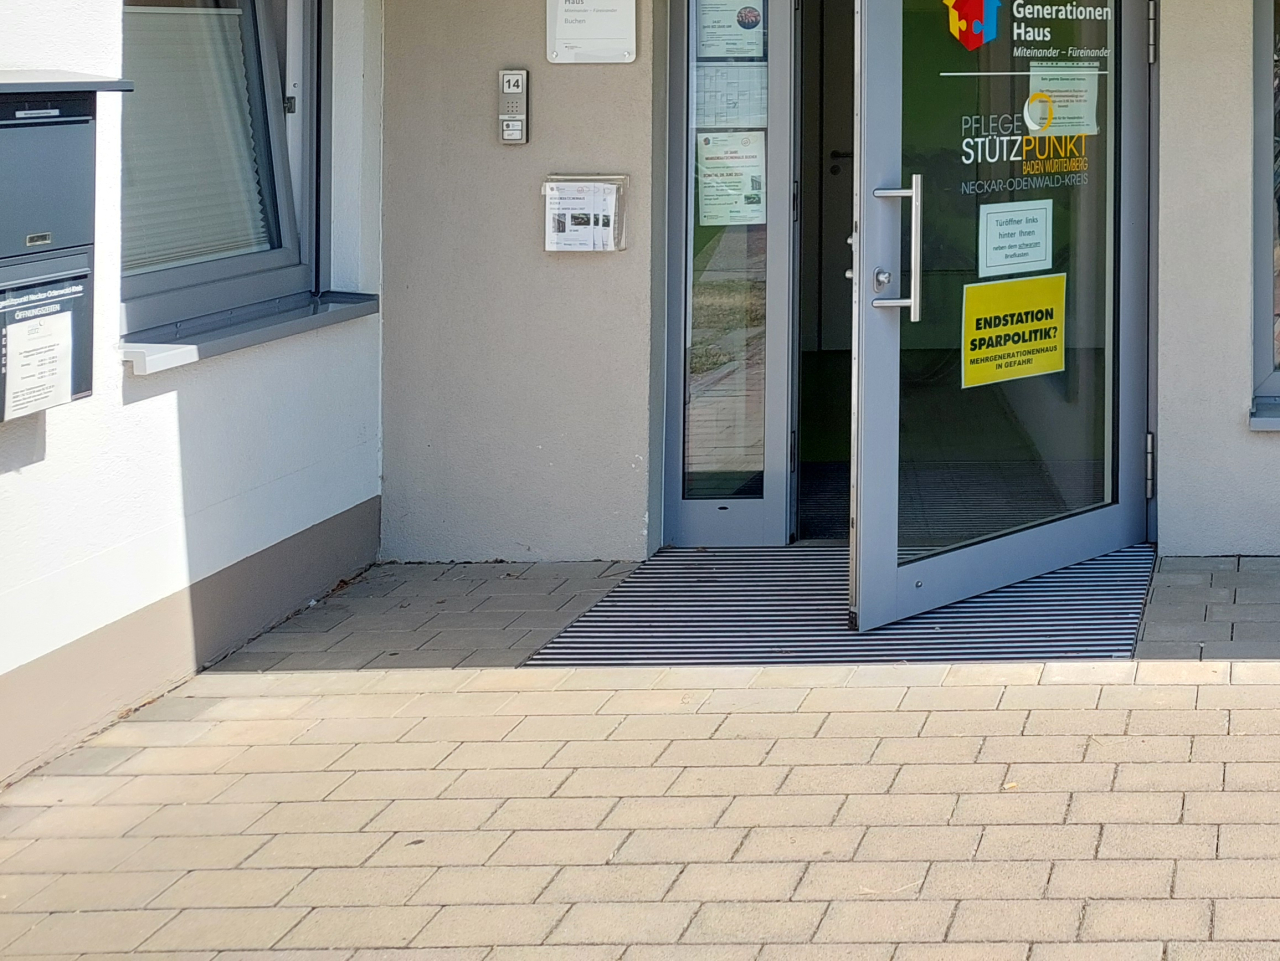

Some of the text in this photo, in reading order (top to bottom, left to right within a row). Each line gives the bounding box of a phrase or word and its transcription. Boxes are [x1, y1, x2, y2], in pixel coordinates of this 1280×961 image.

[1012, 0, 1112, 20] Generationen
[1012, 22, 1051, 41] Haus
[1012, 46, 1060, 58] Miteinander
[1067, 46, 1111, 58] Füreinander
[505, 78, 521, 90] 14
[961, 114, 1022, 137] PFLEGE
[1022, 159, 1044, 175] BADEN
[961, 172, 1089, 195] NECKAR-ODENWALD-KREIS
[995, 216, 1039, 227] Türöffner links
[998, 231, 1017, 240] hinter
[992, 244, 1007, 252] neben
[1018, 241, 1041, 250] schwarzen
[1004, 251, 1029, 260] Briefkasten
[975, 307, 1054, 331] ENDSTATION
[969, 326, 1058, 352] SPARPOLITIK?
[969, 344, 1058, 366] MEHRGENERATIONENHAUS
[995, 357, 1034, 370] IN GEFAHR!
